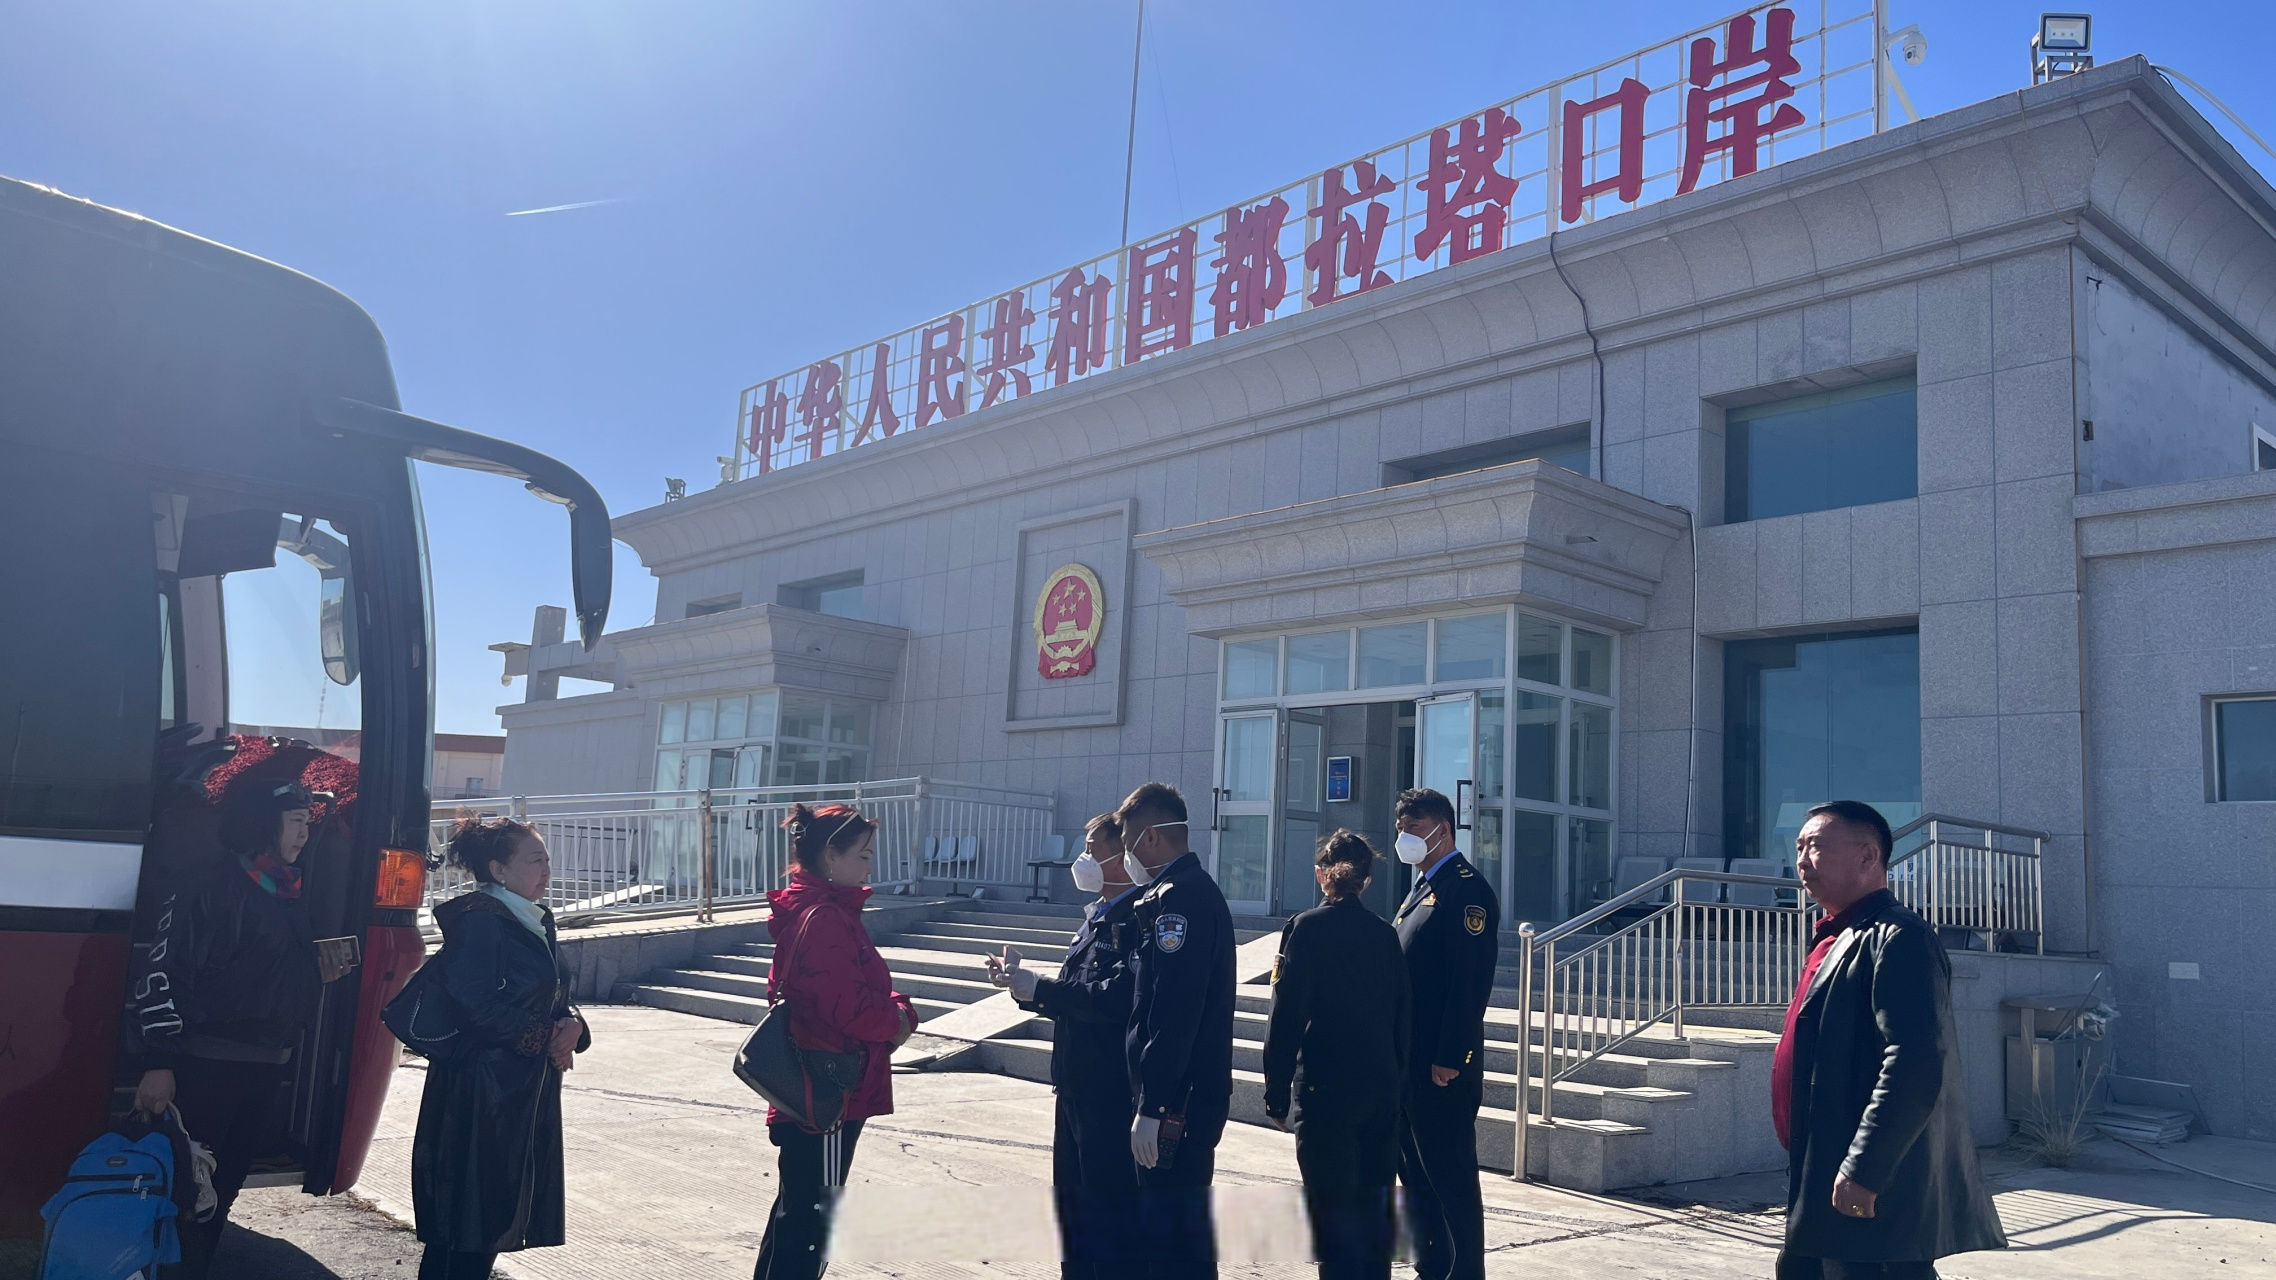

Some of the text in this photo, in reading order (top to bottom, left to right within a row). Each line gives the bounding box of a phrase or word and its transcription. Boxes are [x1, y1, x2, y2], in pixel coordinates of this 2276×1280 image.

[749, 8, 1806, 476] 中华人民共和国都拉塔口岸
